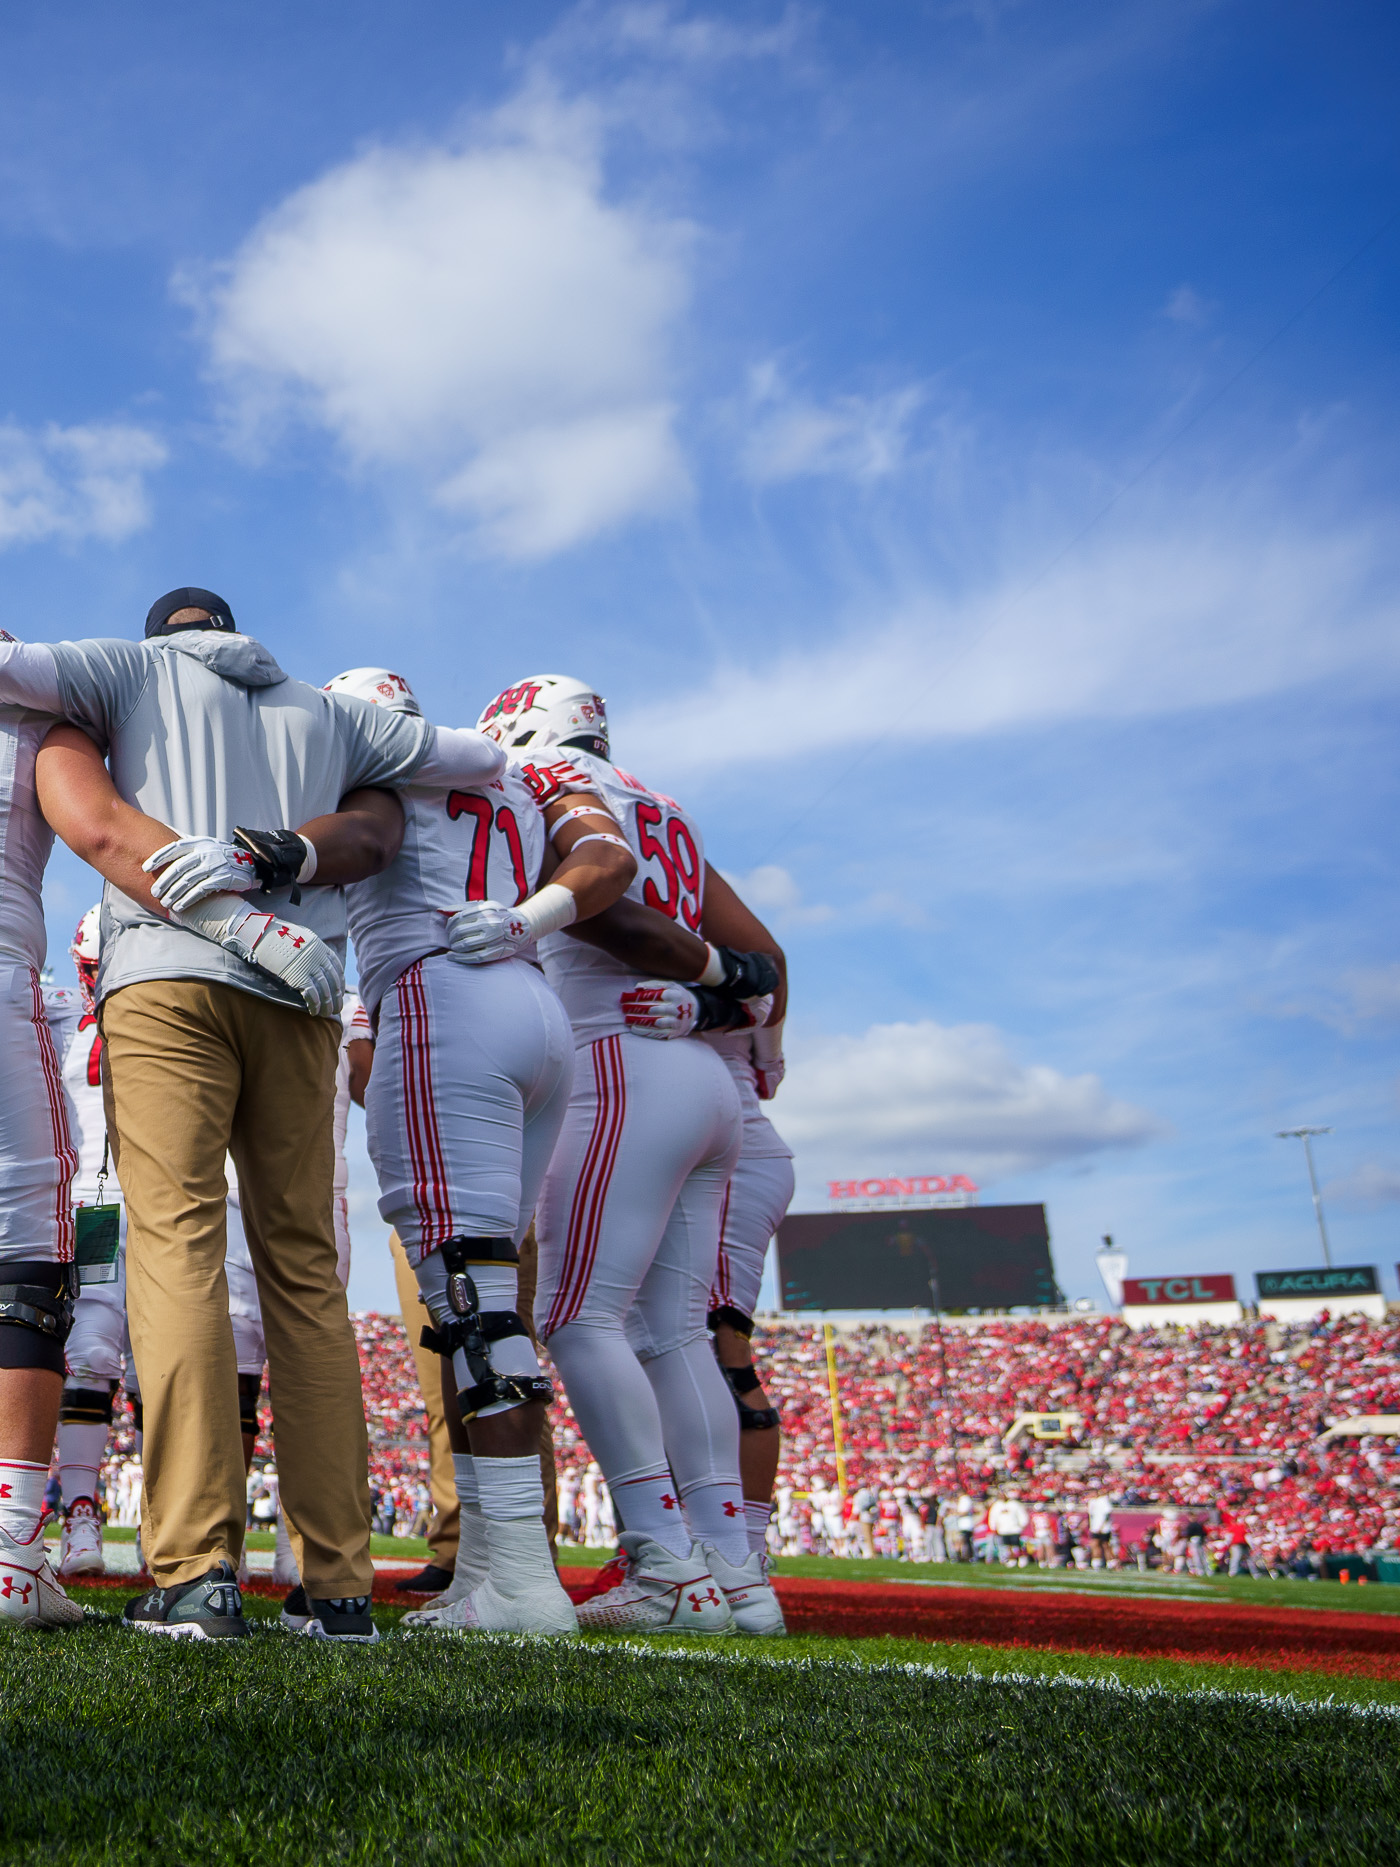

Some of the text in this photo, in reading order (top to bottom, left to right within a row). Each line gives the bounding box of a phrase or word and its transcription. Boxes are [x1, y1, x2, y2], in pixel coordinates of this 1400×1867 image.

[446, 789, 529, 907] 71
[636, 801, 702, 933] 59
[828, 1174, 979, 1199] HONDA
[1138, 1278, 1216, 1300] TCL
[1279, 1272, 1371, 1292] ACURA
